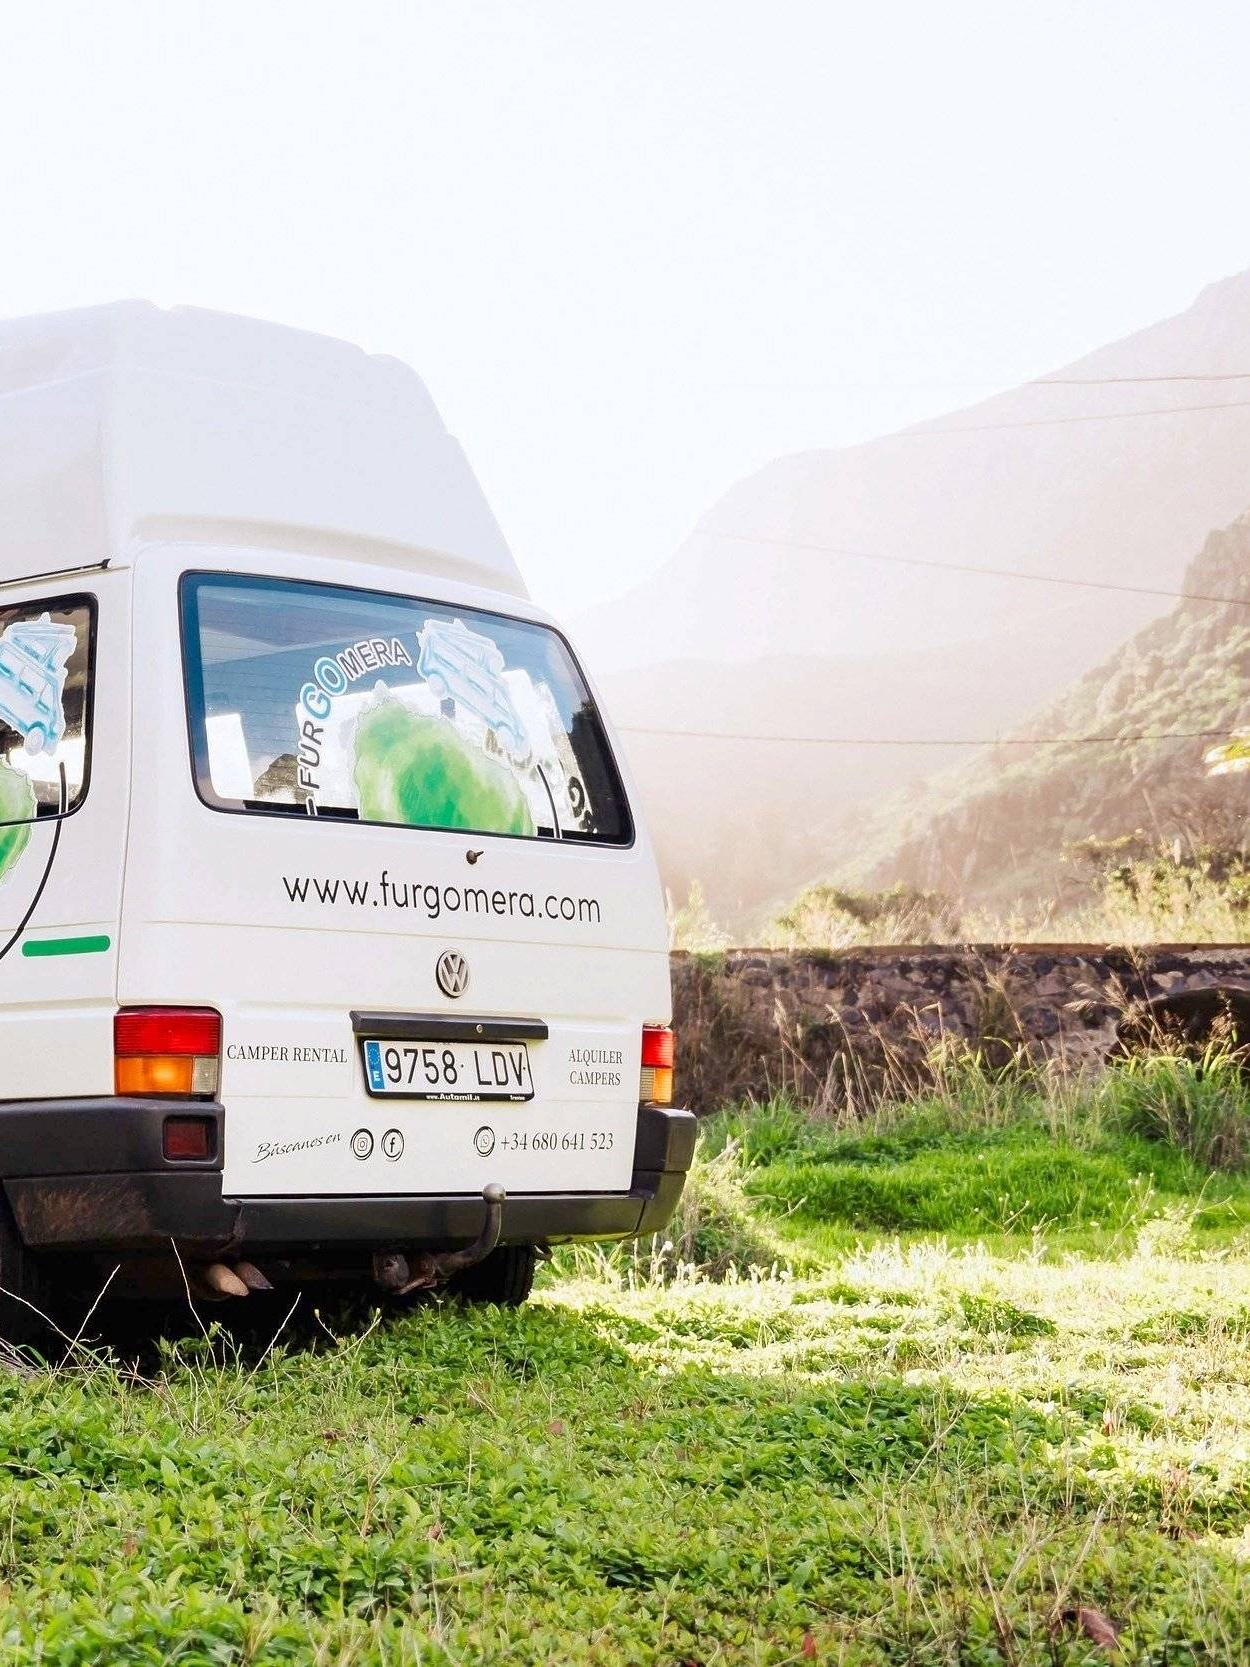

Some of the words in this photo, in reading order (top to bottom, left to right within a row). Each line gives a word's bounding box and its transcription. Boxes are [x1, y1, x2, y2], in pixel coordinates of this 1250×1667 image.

[299, 638, 411, 790] FURGOMERA
[283, 871, 601, 922] www.furgomera.com
[227, 1045, 289, 1061] CAMPER
[293, 1047, 348, 1063] RENTAL
[569, 1049, 623, 1066] ALQUILER
[384, 1048, 458, 1084] 9758
[474, 1050, 523, 1087] LDV
[569, 1070, 621, 1086] CAMPERS
[501, 1132, 528, 1150] +34
[532, 1132, 558, 1151] 680
[561, 1133, 585, 1151] 641
[590, 1132, 614, 1151] 523
